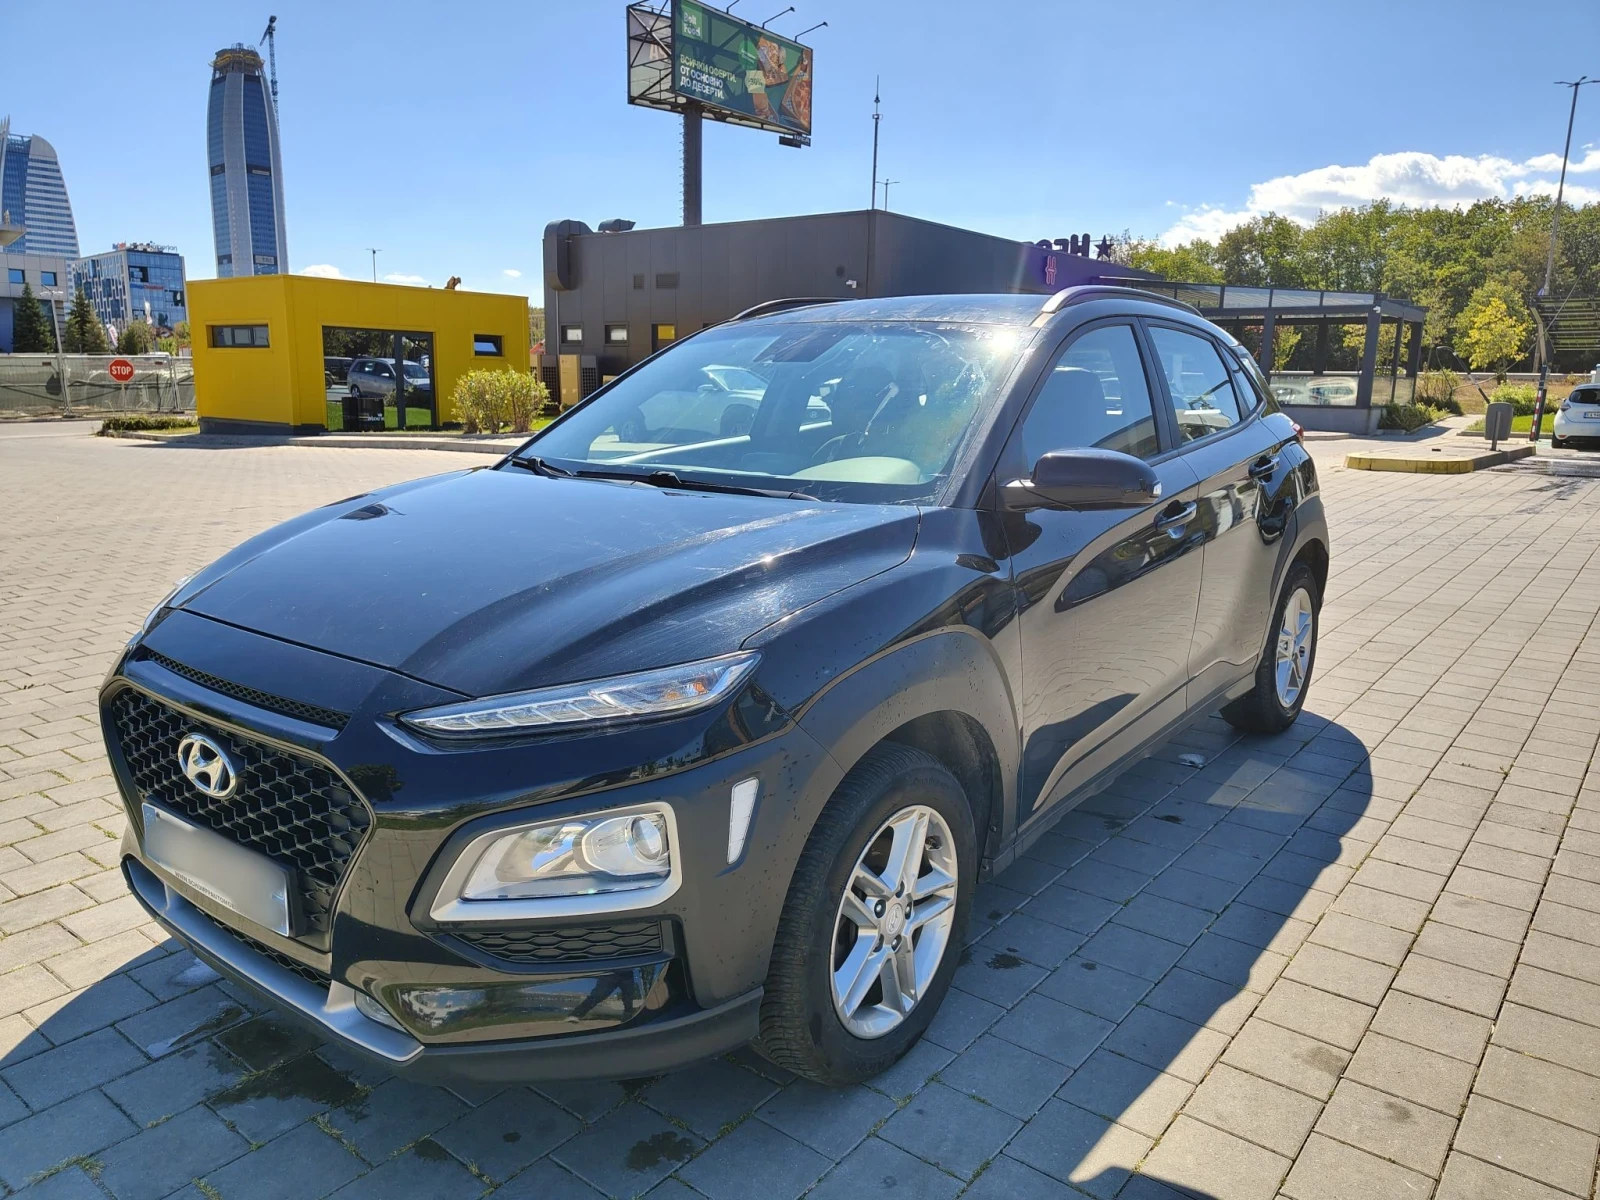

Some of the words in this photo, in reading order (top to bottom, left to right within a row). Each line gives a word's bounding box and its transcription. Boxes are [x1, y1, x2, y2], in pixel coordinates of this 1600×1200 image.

[683, 22, 701, 36] Food
[680, 54, 708, 73] ВСИЧКИ
[680, 65, 690, 76] ОТ
[690, 69, 723, 89] ОСНОВНО
[680, 76, 691, 87] ДО
[111, 366, 132, 375] STOP
